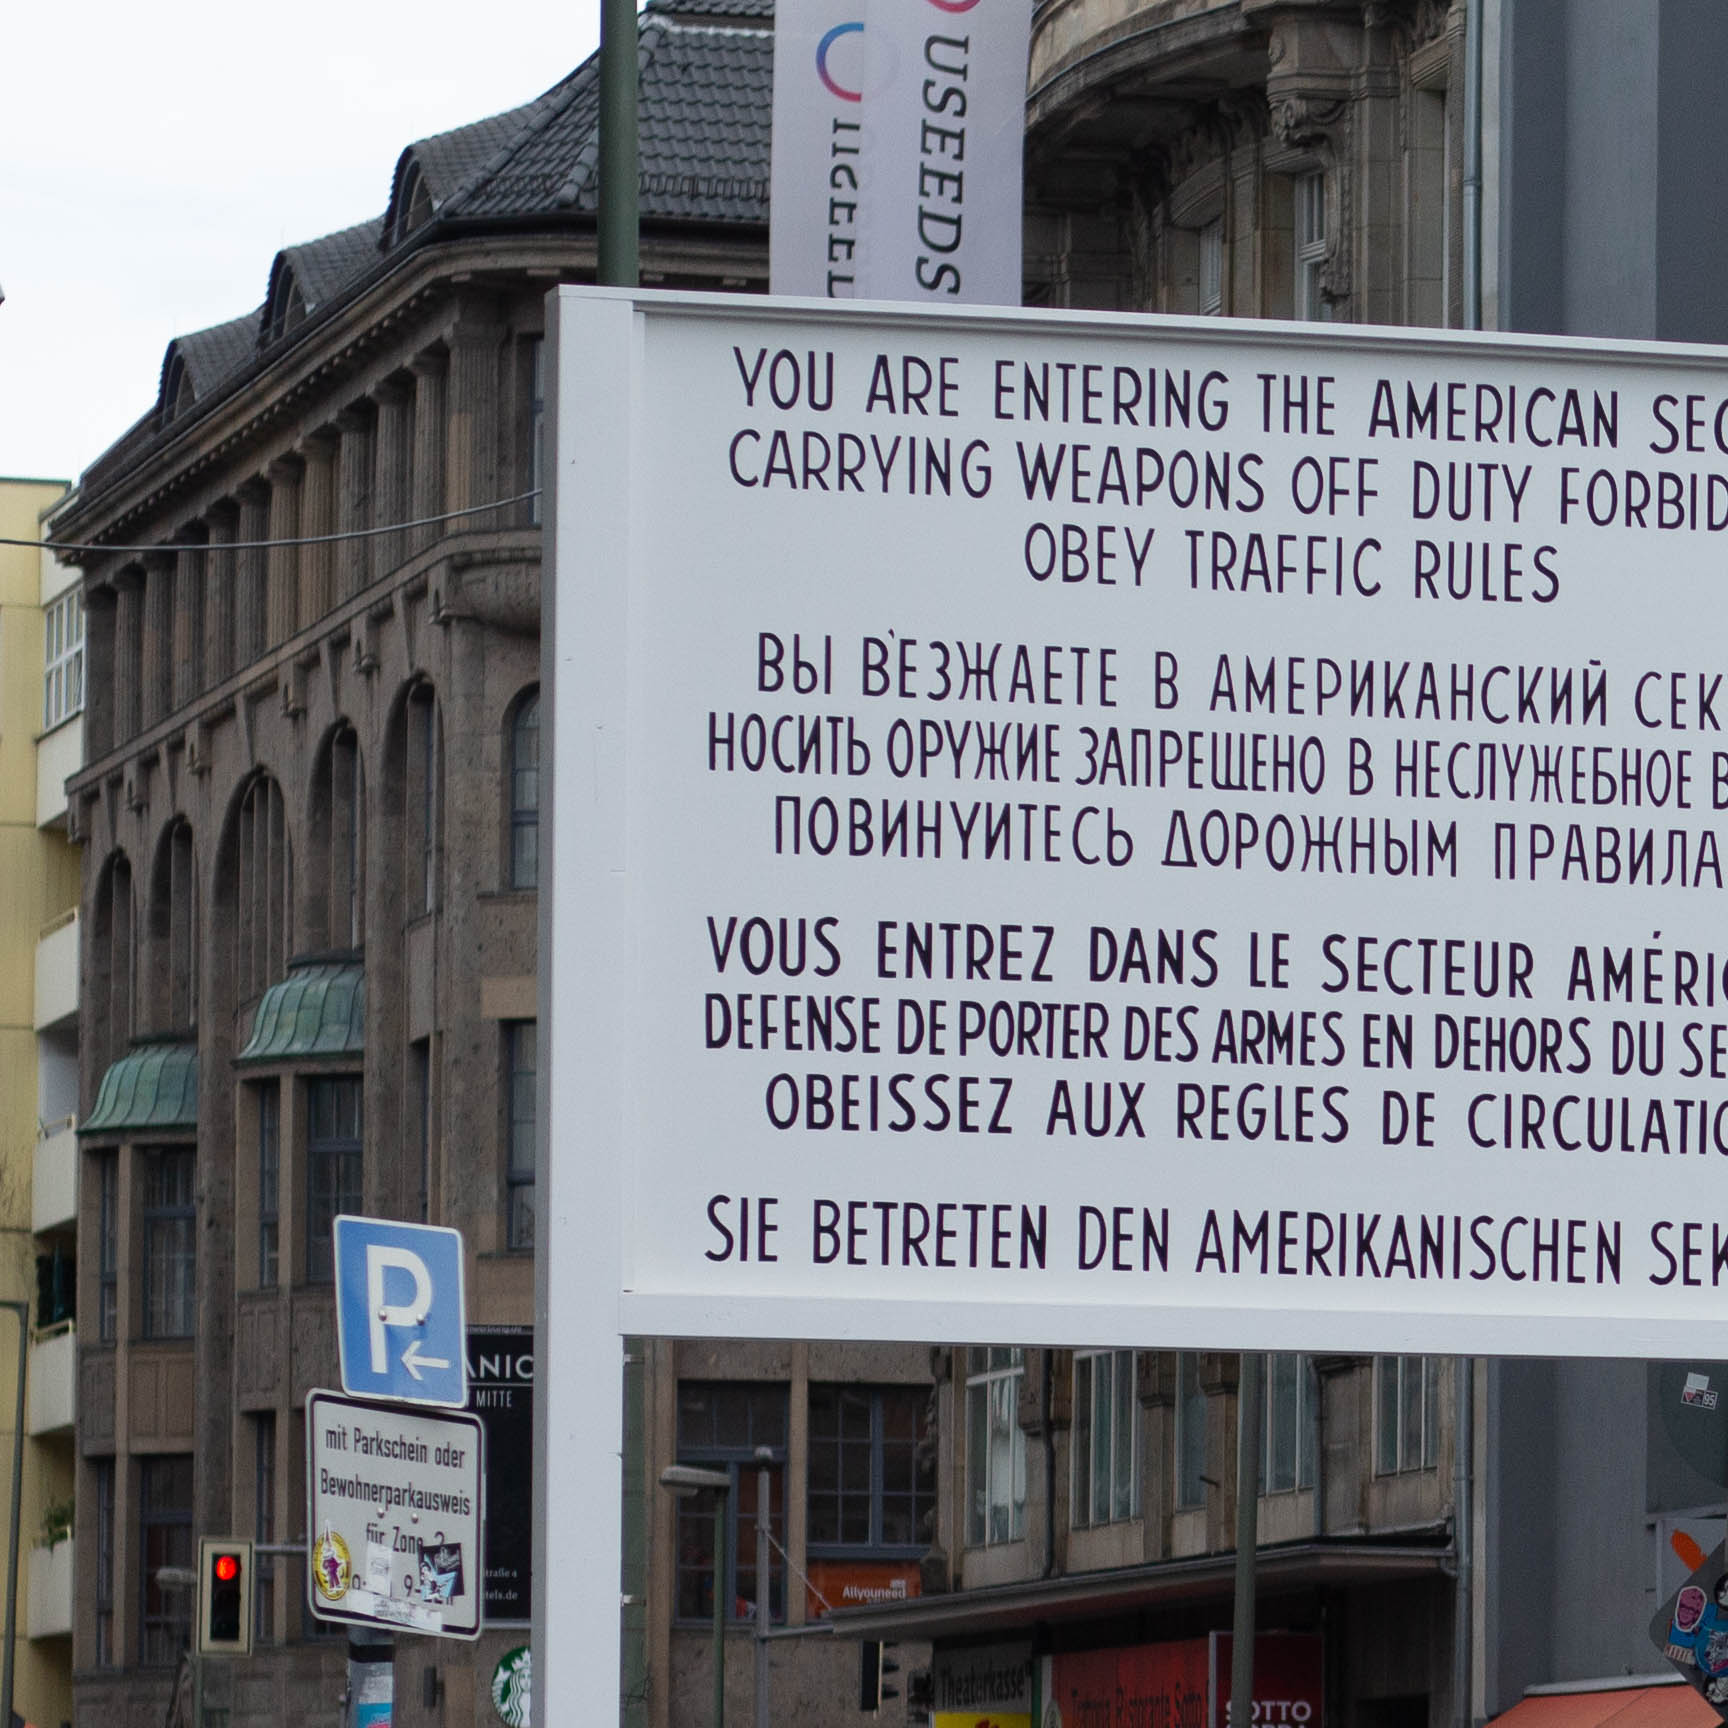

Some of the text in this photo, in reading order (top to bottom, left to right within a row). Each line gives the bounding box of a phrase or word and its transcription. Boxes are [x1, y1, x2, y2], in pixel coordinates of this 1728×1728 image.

[732, 346, 834, 412] YOU
[865, 354, 959, 417] ARE
[994, 359, 1229, 432] ENTERING
[1256, 373, 1335, 436] THE
[1368, 379, 1618, 449] AMERICAN
[729, 428, 992, 499] CARRYING
[1015, 441, 1265, 513] WEAPONS
[1291, 455, 1379, 517] OFF
[1413, 460, 1533, 523] DUTY
[1024, 522, 1560, 603] OBEY TRAFFIC RULES
[758, 632, 832, 695] ВЫ
[1155, 651, 1179, 710] В
[1209, 658, 1607, 727] АМЕРИКАНСКИЙ
[708, 711, 871, 776] НОСИТЬ
[886, 718, 1060, 783] ОРУЖИЕ
[1075, 726, 1325, 795] ЗАПРЕЩЕНО
[1349, 737, 1374, 796] В
[1396, 739, 1692, 809] НЕСЛУЖЕБНОЕ
[1160, 809, 1457, 878] ДОРОЖНЫМ
[706, 916, 841, 978] VOUS
[877, 920, 1055, 982] ENTREZ
[1089, 926, 1218, 988] DANS
[1250, 931, 1290, 989] LE
[1321, 933, 1534, 999] SECTEUR
[705, 993, 881, 1054] DEFENSE
[897, 998, 947, 1056] DE
[959, 1000, 1109, 1060] PORTER
[1124, 1005, 1200, 1063] DES
[1211, 1009, 1346, 1067] ARMES
[1363, 1013, 1413, 1070] EN
[1435, 1013, 1591, 1074] DEHORS
[1612, 1020, 1664, 1077] DU
[765, 1072, 1013, 1134] OBEISSEZ
[1046, 1079, 1146, 1138] AUX
[1177, 1082, 1349, 1144] REGLES
[1382, 1090, 1435, 1147] DE
[704, 1194, 778, 1262] SIE
[813, 1199, 1047, 1270] BETRETEN
[1078, 1205, 1169, 1272] DEN
[1195, 1209, 1621, 1285] AMERIKANISCHEN
[476, 1390, 512, 1409] MITTE
[325, 1424, 466, 1469] mit Parkschein oder
[319, 1468, 471, 1516] Bewohnerparkausweis
[366, 1521, 385, 1546] für
[1225, 1699, 1312, 1722] TTO
